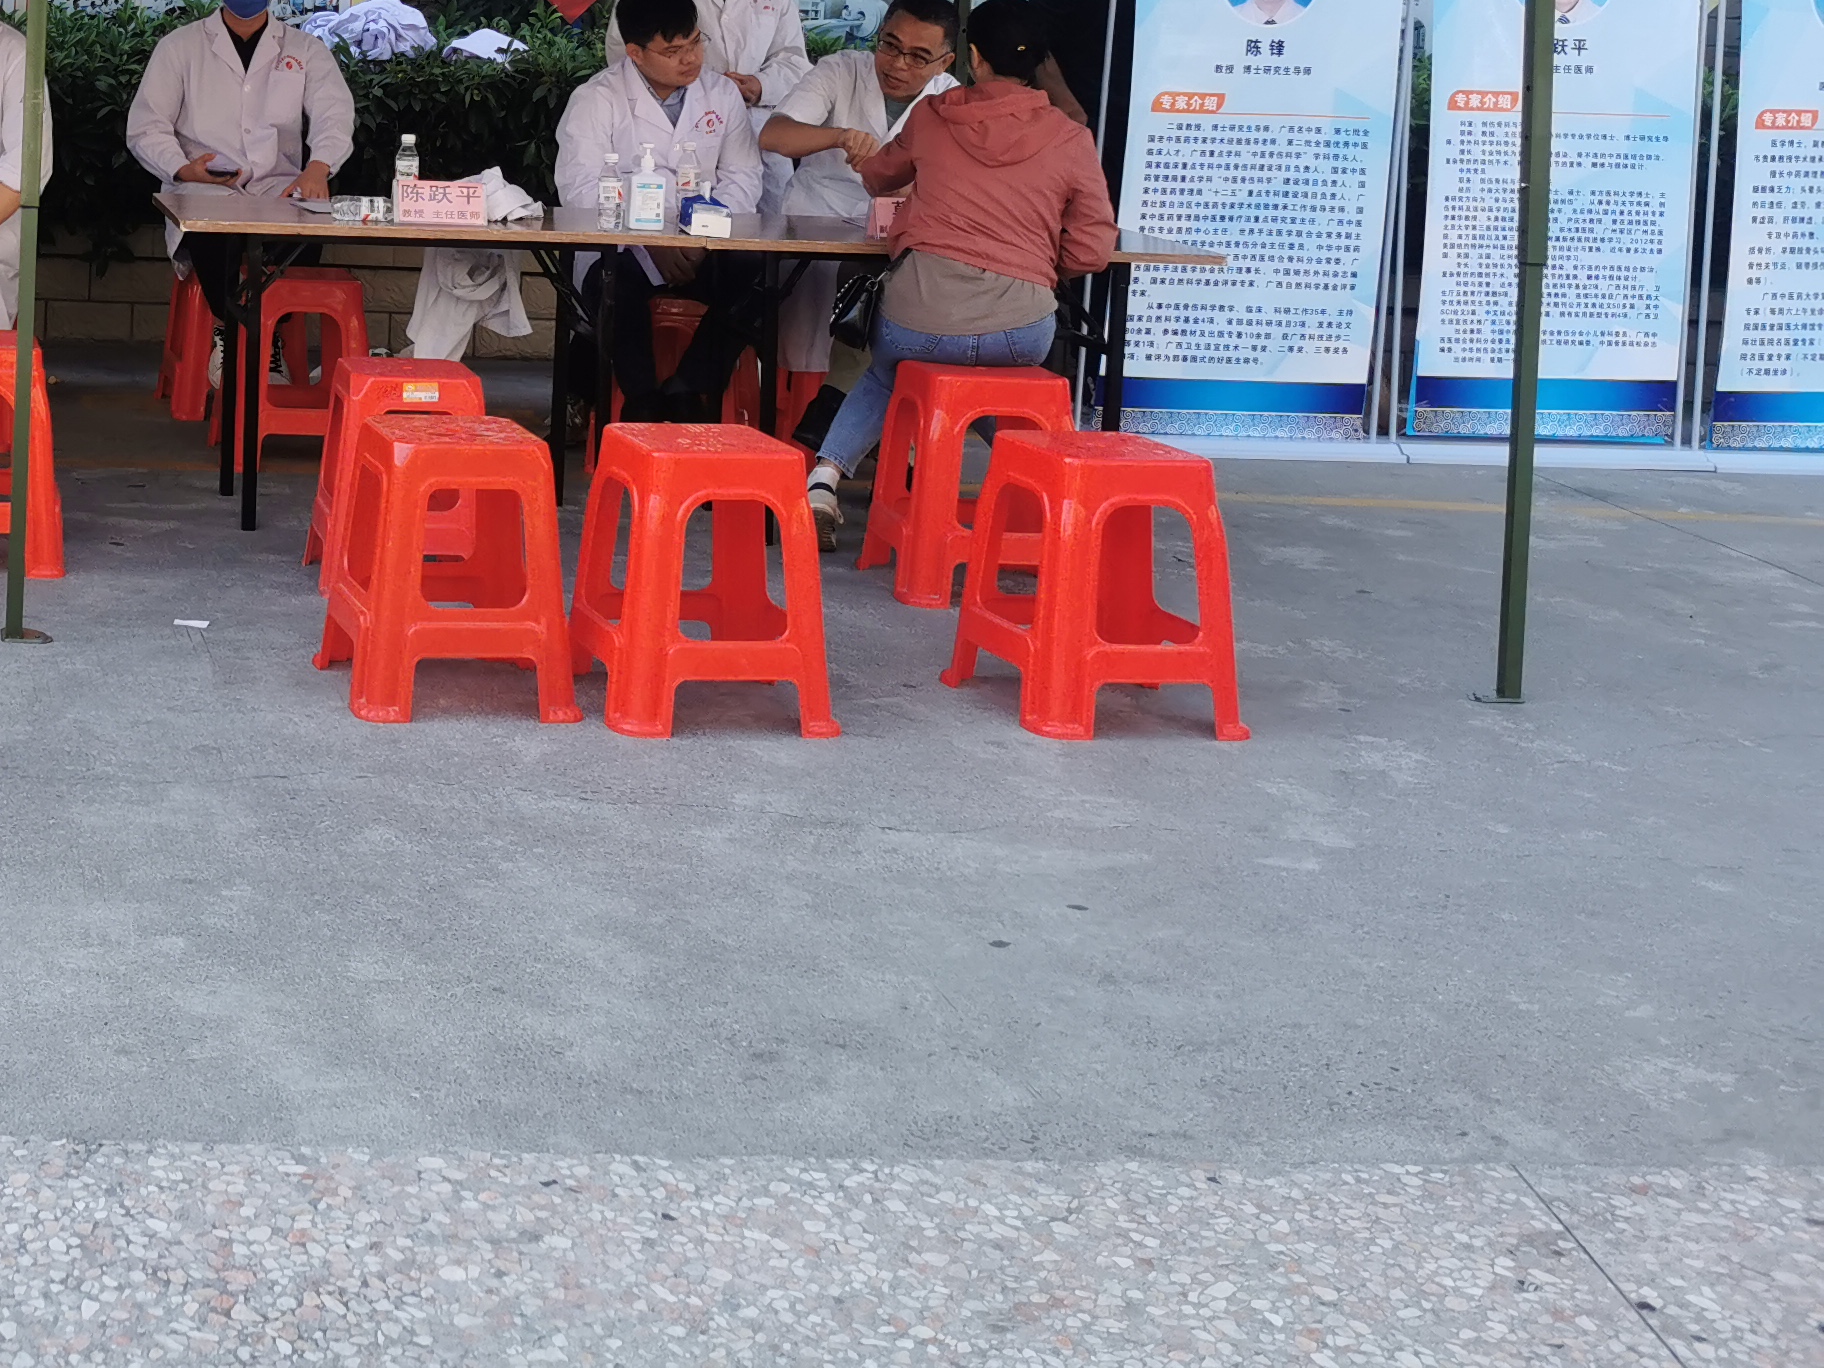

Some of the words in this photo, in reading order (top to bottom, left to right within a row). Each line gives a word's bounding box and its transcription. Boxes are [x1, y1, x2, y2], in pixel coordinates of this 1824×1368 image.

[1159, 94, 1219, 111] 专家介绍
[1454, 93, 1513, 109] 专家介绍
[1761, 111, 1814, 128] 专家介绍
[401, 183, 482, 205] 陈跃平
[401, 208, 425, 219] 教授
[432, 209, 481, 220] 主任医师
